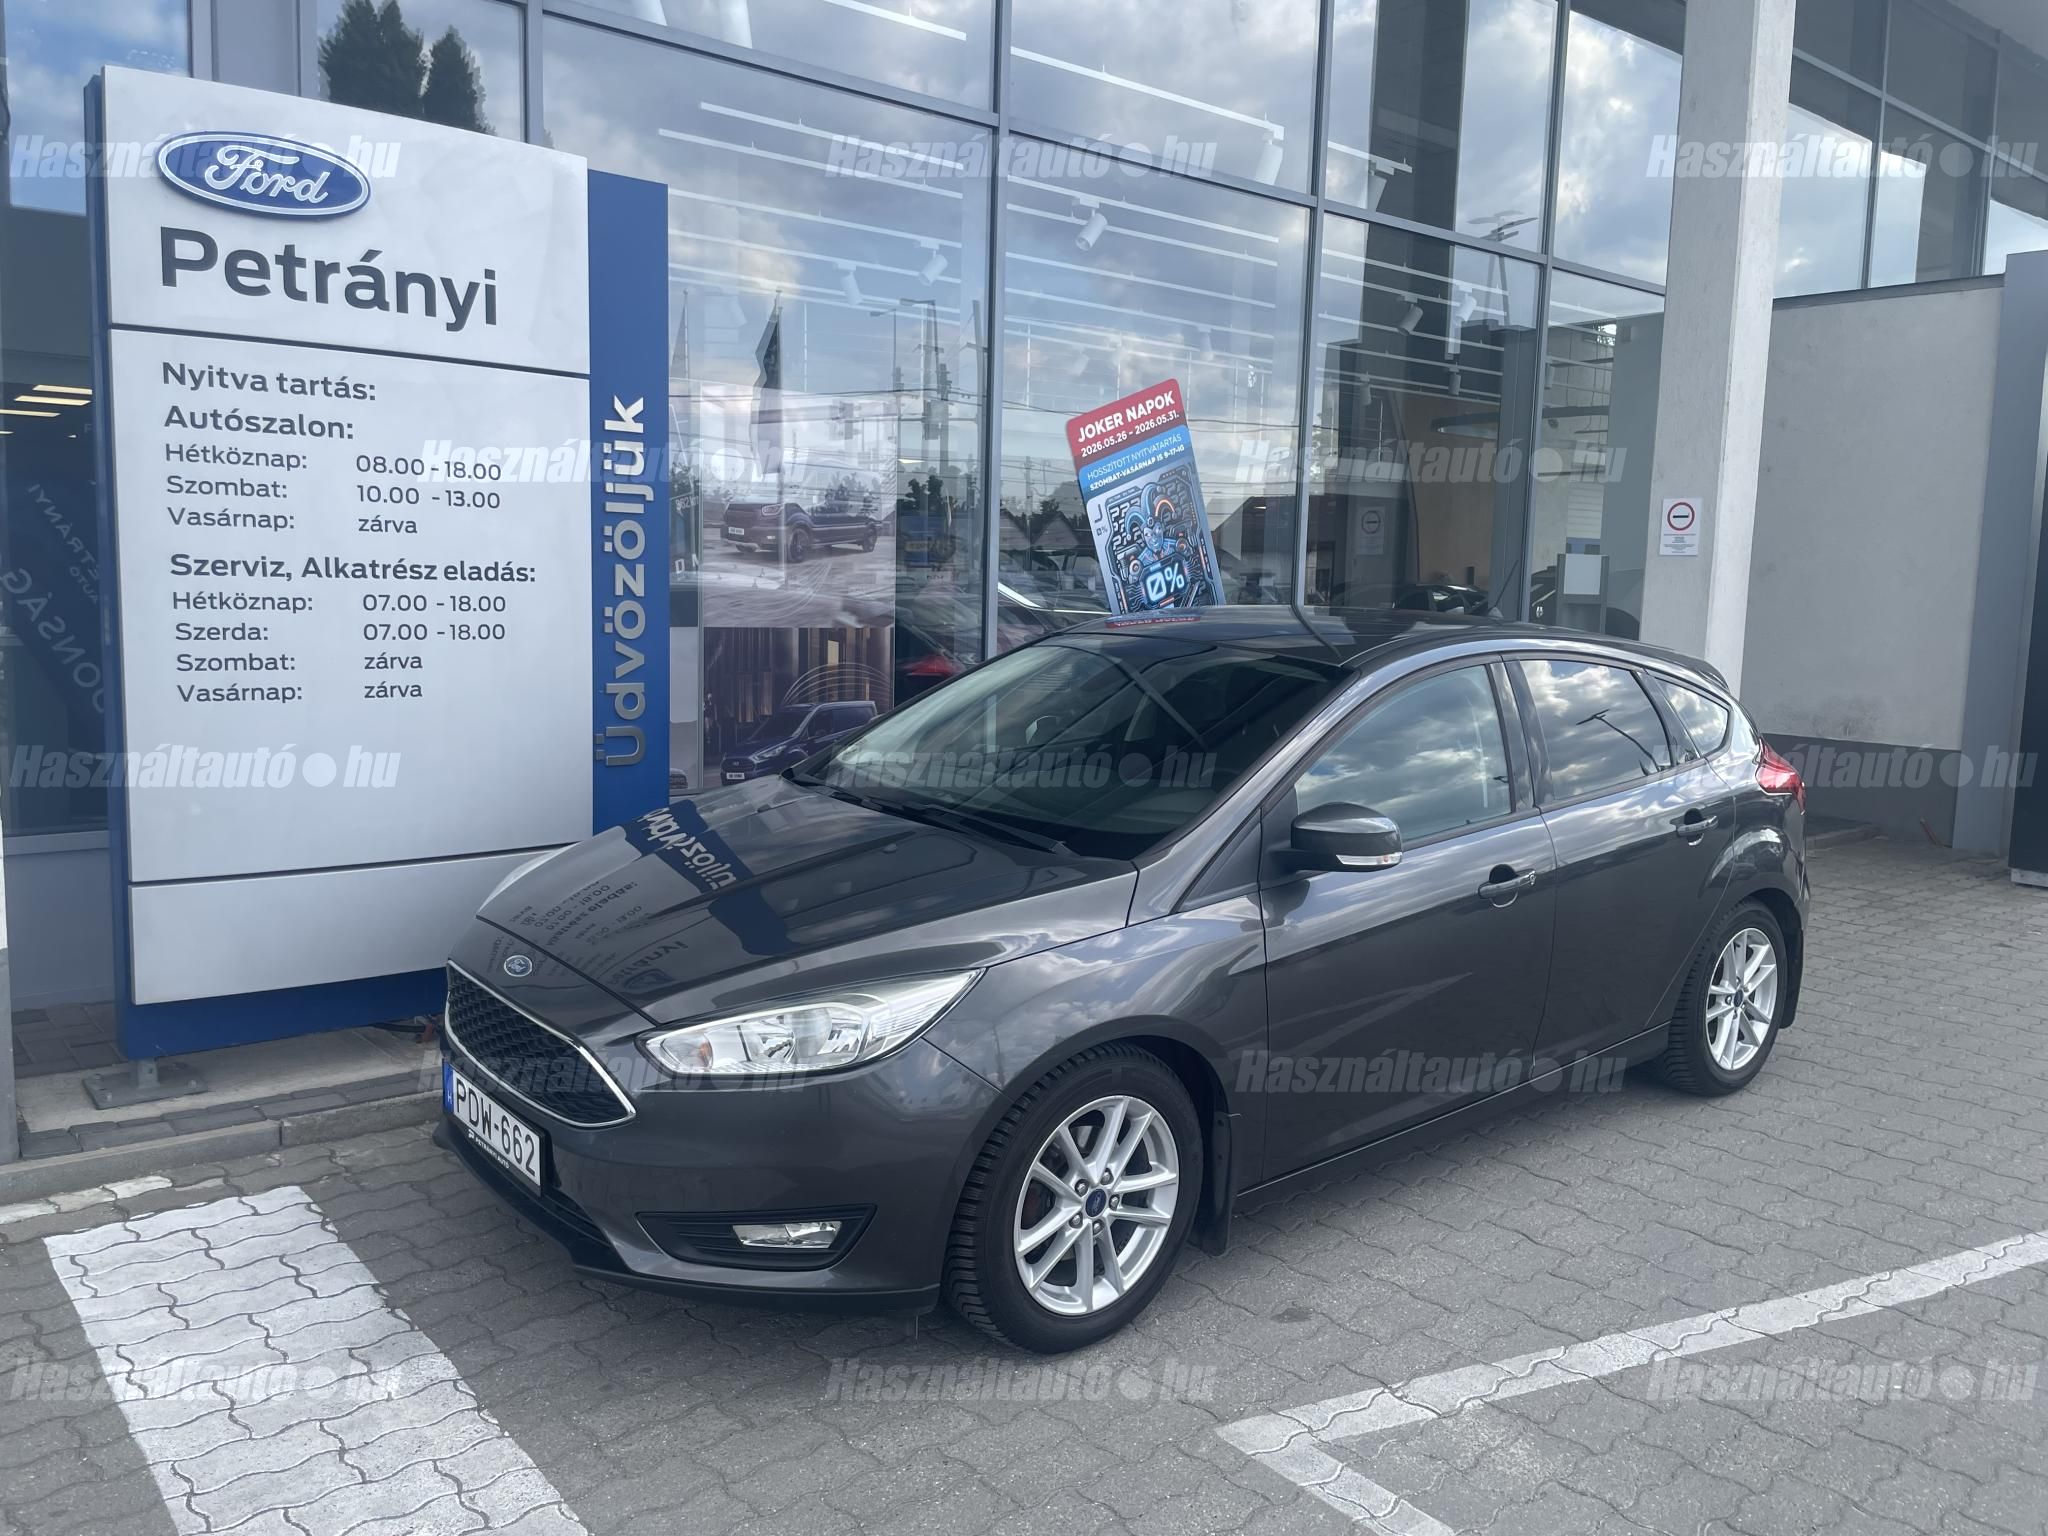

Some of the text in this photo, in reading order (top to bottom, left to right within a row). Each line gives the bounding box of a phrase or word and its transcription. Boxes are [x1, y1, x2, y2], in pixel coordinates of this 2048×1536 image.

[204, 144, 330, 204] Ford
[160, 226, 497, 333] Petrányi
[162, 361, 376, 401] Nyitva tartás:
[164, 405, 354, 440] Autószalon:
[1078, 390, 1175, 443] JOKER NAPOK
[1081, 430, 1128, 458] 2026.05.26
[1135, 409, 1180, 435] 2026.05.31.
[165, 443, 307, 471] Hétköznap:
[356, 455, 425, 476] 08.00
[166, 475, 287, 499] Szombat:
[357, 484, 420, 505] 10.00
[167, 507, 418, 534] Vasárnap: zárva
[170, 553, 536, 583] Szerviz, Alkatrész eladás:
[595, 394, 654, 767] Üdvözöljük
[172, 591, 313, 614] Hétköznap:
[363, 594, 427, 612] 07.00
[175, 622, 268, 641] Szerda:
[363, 623, 428, 641] 07.00
[176, 651, 423, 672] Szombat: zárva
[177, 681, 423, 704] Vasárnap: zárva
[456, 1077, 536, 1177] PDW-662
